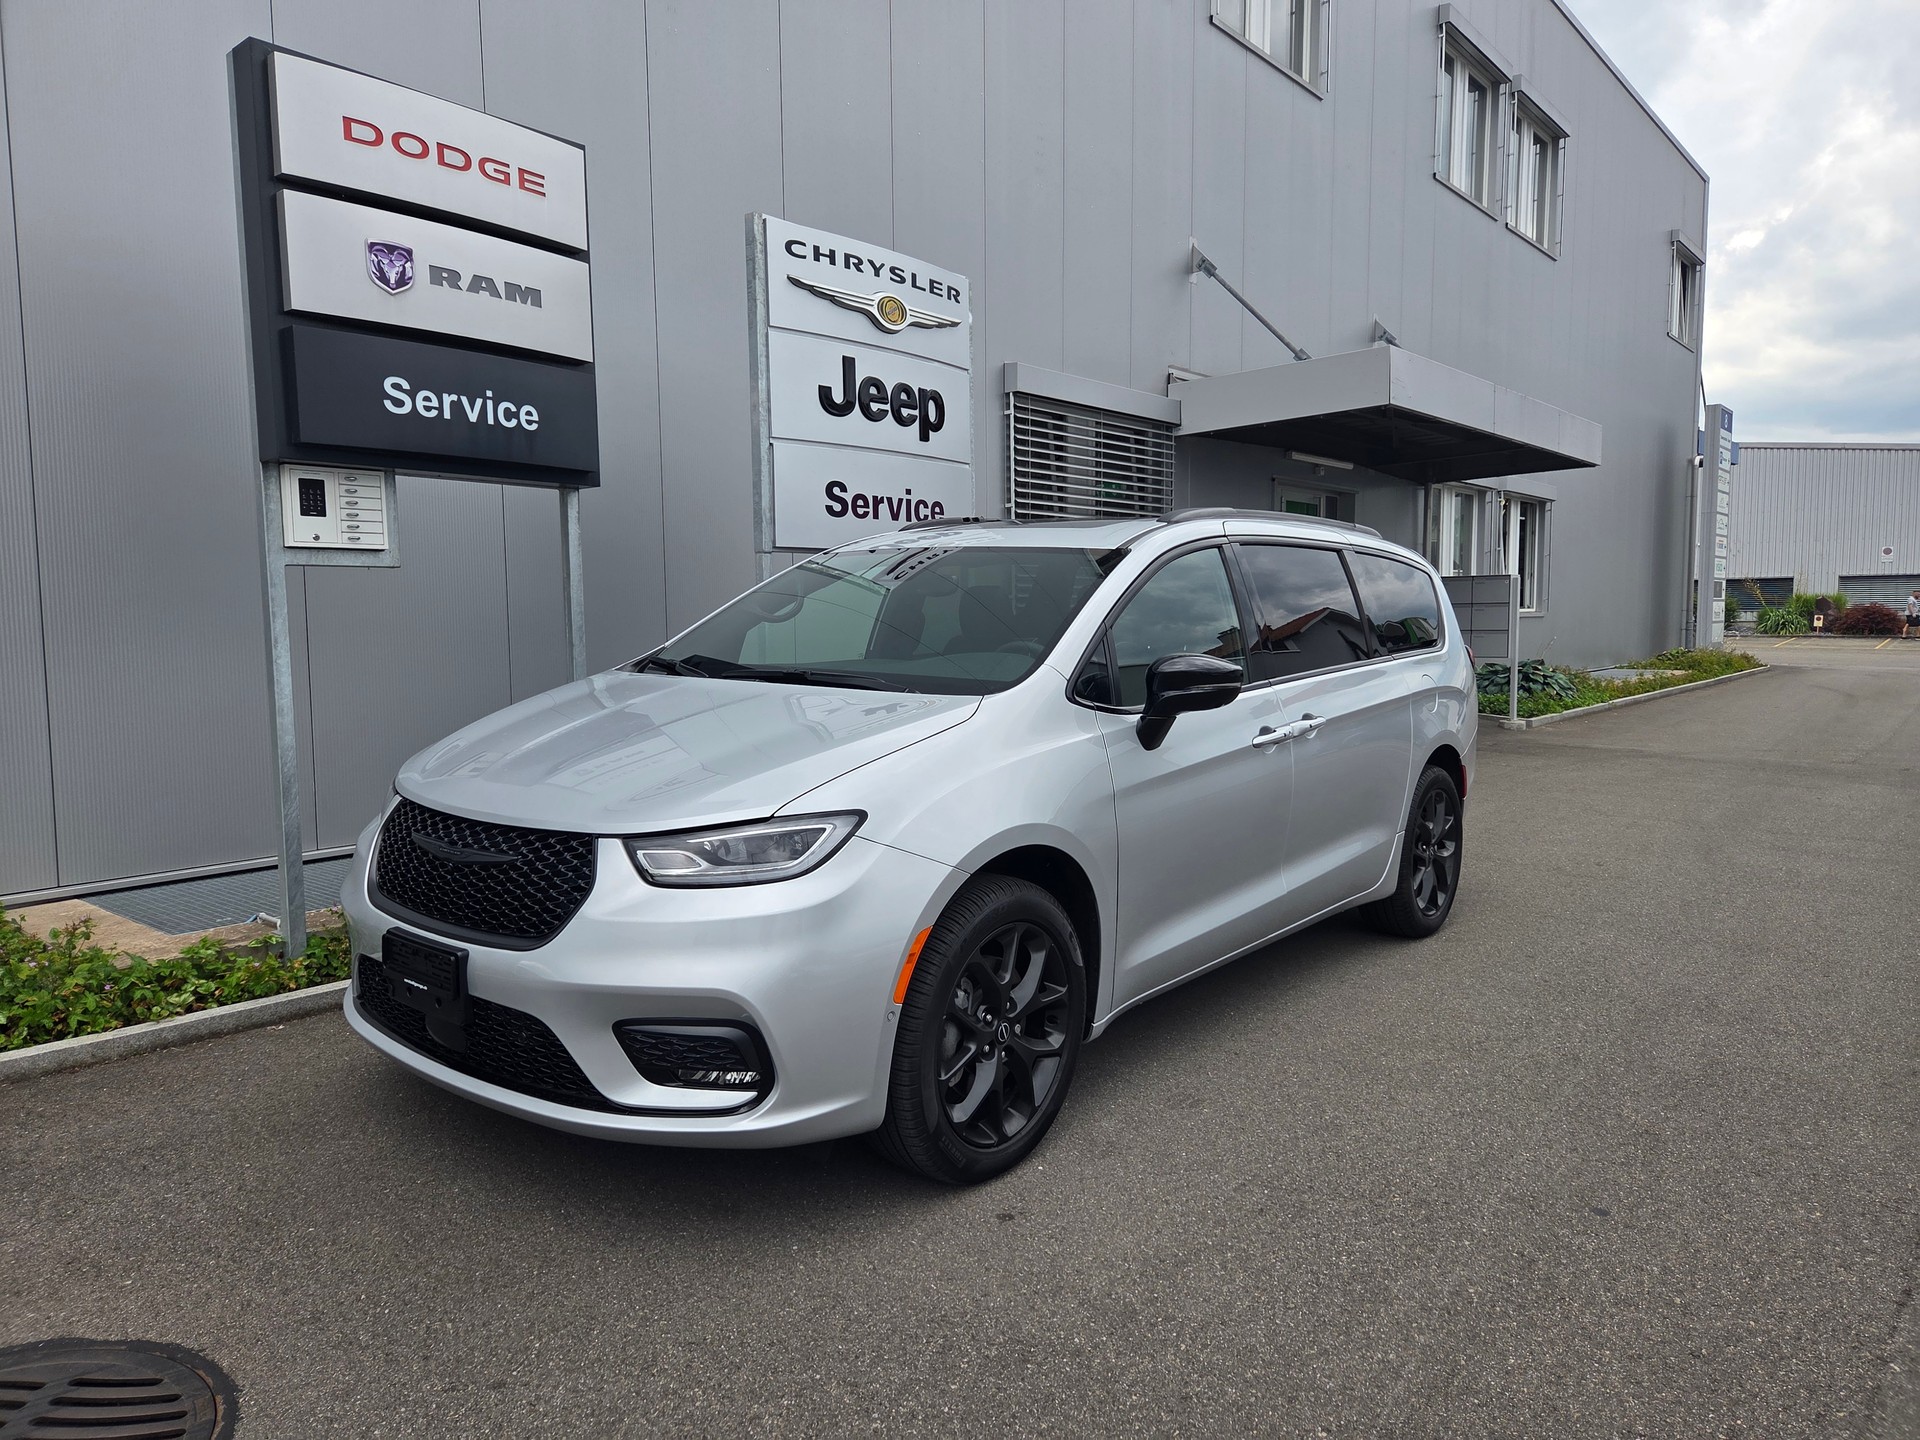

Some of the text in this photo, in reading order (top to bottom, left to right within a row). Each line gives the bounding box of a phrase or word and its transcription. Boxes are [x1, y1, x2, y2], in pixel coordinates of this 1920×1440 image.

[342, 115, 547, 198] DODGE
[428, 264, 543, 309] RAM
[784, 239, 961, 304] CHRYSLER
[383, 376, 540, 431] Service
[818, 354, 945, 442] Jeep
[824, 480, 945, 523] Service
